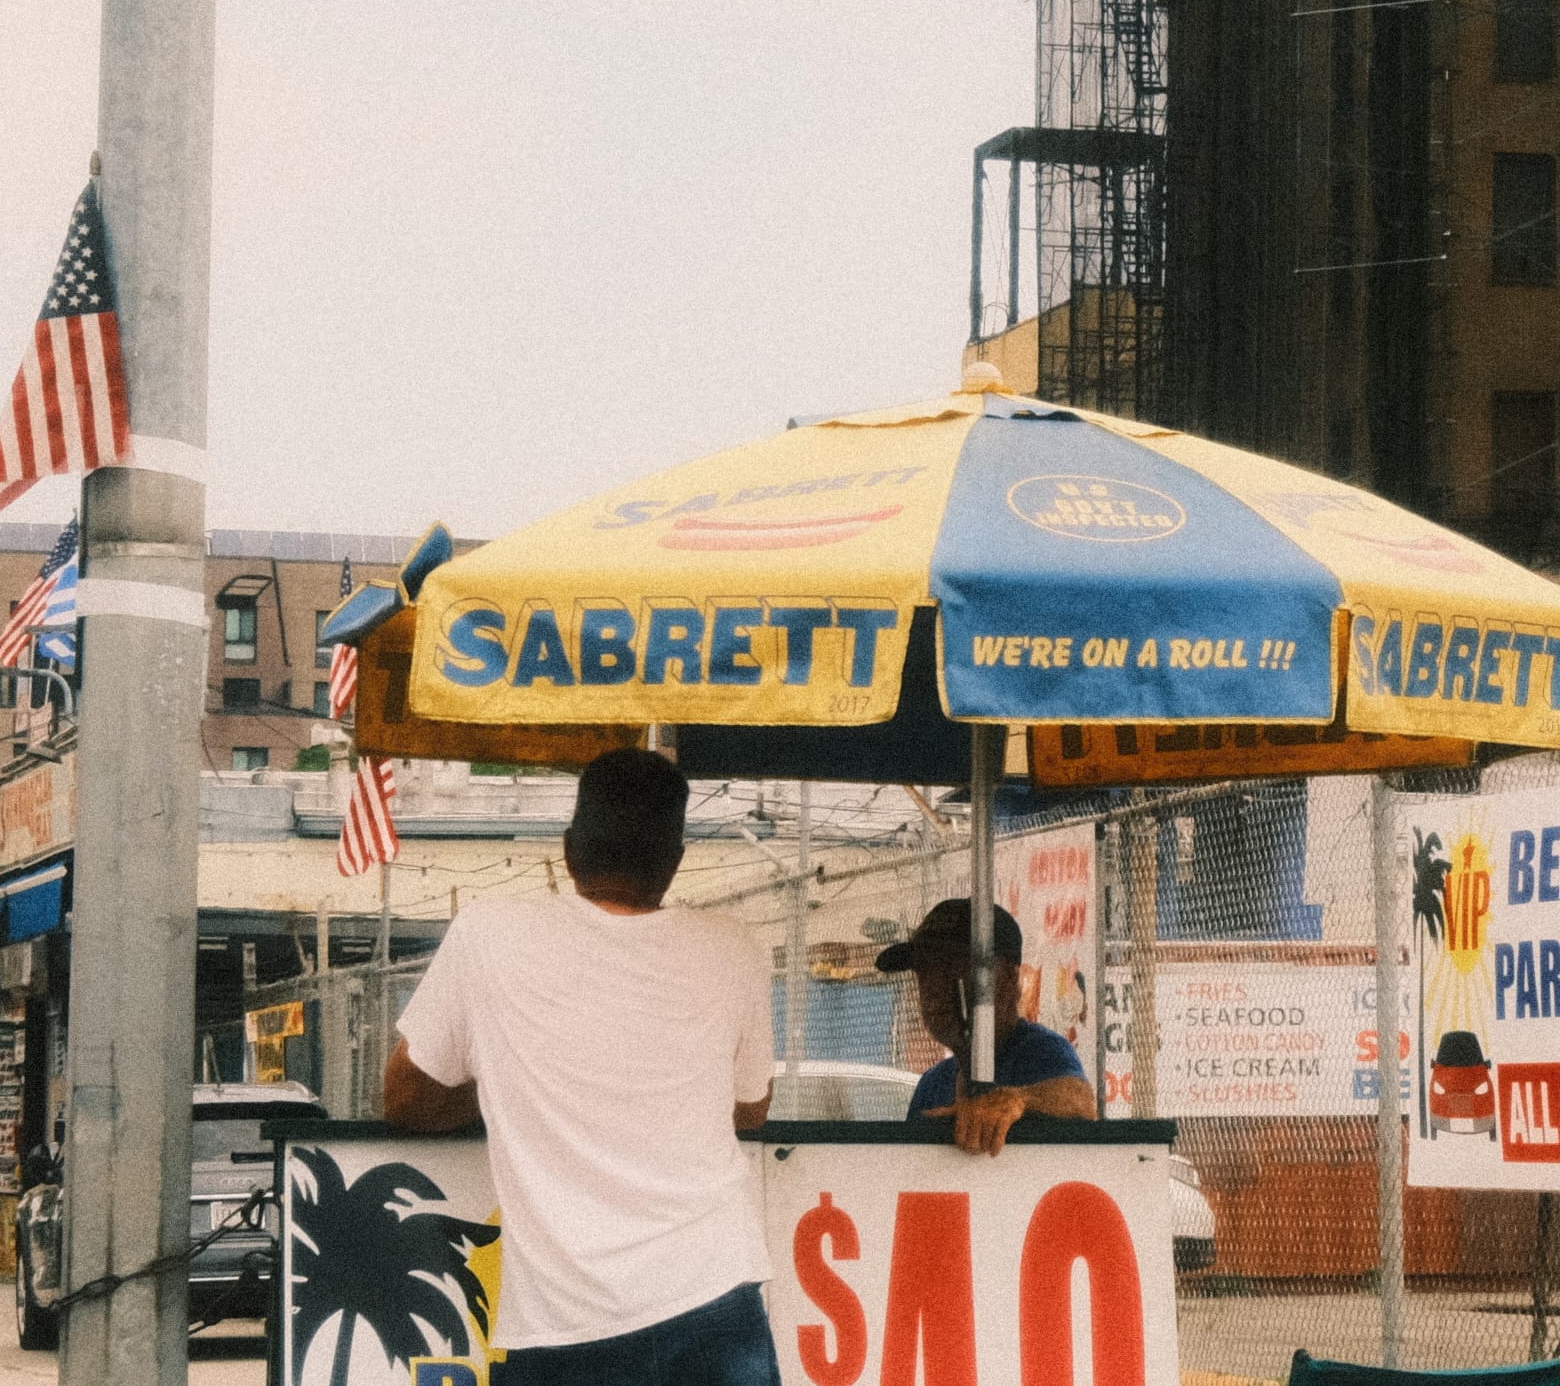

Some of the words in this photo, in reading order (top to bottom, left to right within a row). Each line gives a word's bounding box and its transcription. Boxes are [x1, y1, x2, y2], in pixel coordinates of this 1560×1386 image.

[435, 596, 900, 689] SABRETT
[973, 635, 1074, 668] WE'RE
[1082, 637, 1130, 668] ON
[1137, 641, 1159, 668] A
[1168, 640, 1249, 670] ROLL
[1445, 868, 1492, 952] VIP
[1187, 983, 1248, 1002] FRIES
[1186, 1007, 1306, 1027] SEAFOOD
[1185, 1033, 1260, 1052] COTTON
[1264, 1030, 1327, 1052] CANDY
[1187, 1058, 1225, 1079] ICE
[1231, 1058, 1321, 1078] CREAM
[1188, 1082, 1299, 1103] SLUSHIES
[1509, 1080, 1560, 1146] ALL
